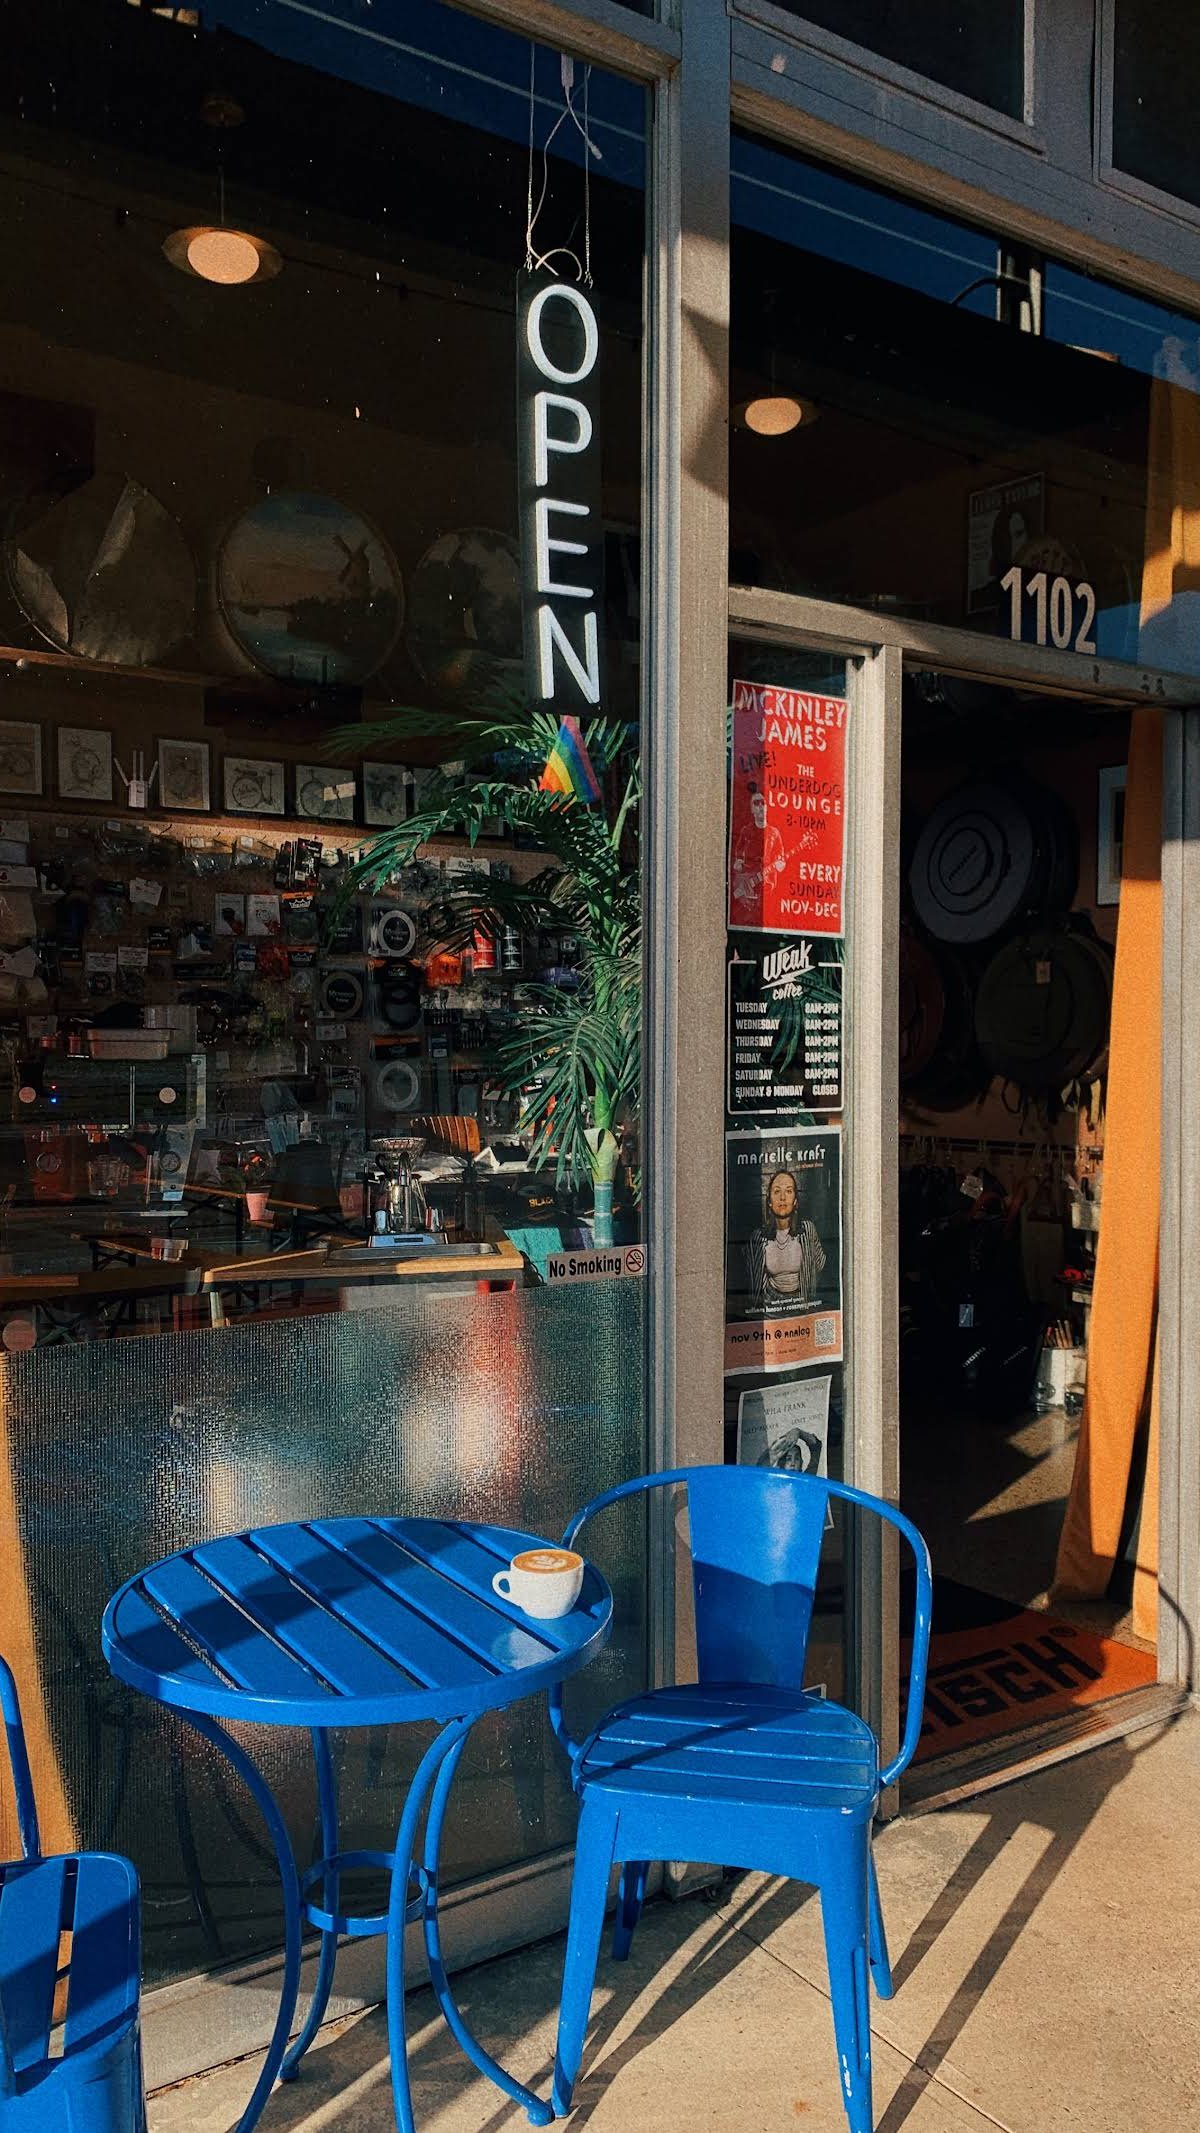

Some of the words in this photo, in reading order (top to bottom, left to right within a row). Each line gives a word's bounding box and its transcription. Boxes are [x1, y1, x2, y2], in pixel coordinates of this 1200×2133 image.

[527, 284, 600, 704] OPEN
[1000, 566, 1096, 655] 1102
[739, 686, 846, 728] MCKINLEY
[756, 718, 827, 752] JAMES
[796, 763, 815, 778] THE
[768, 774, 841, 798] UNDERDOG
[768, 791, 841, 816] LOUNGE
[800, 862, 841, 883] EVERY
[789, 882, 840, 899] SUNDAY
[780, 899, 839, 918] NOV-DEC
[762, 940, 813, 982] Weak
[772, 983, 803, 1001] coffee
[736, 1002, 767, 1013] TUESDAY
[736, 1019, 780, 1030] WEDNESDAY
[736, 1036, 773, 1047] THURSDAY
[736, 1053, 761, 1064] FRIDAY
[736, 1069, 773, 1081] SATURDAY
[736, 1086, 765, 1098] SUNDAY
[773, 1085, 804, 1097] MONDAY
[812, 1084, 839, 1096] CLOSED
[549, 1260, 566, 1278] No
[569, 1255, 622, 1275] Smoking
[730, 1334, 750, 1344] nov
